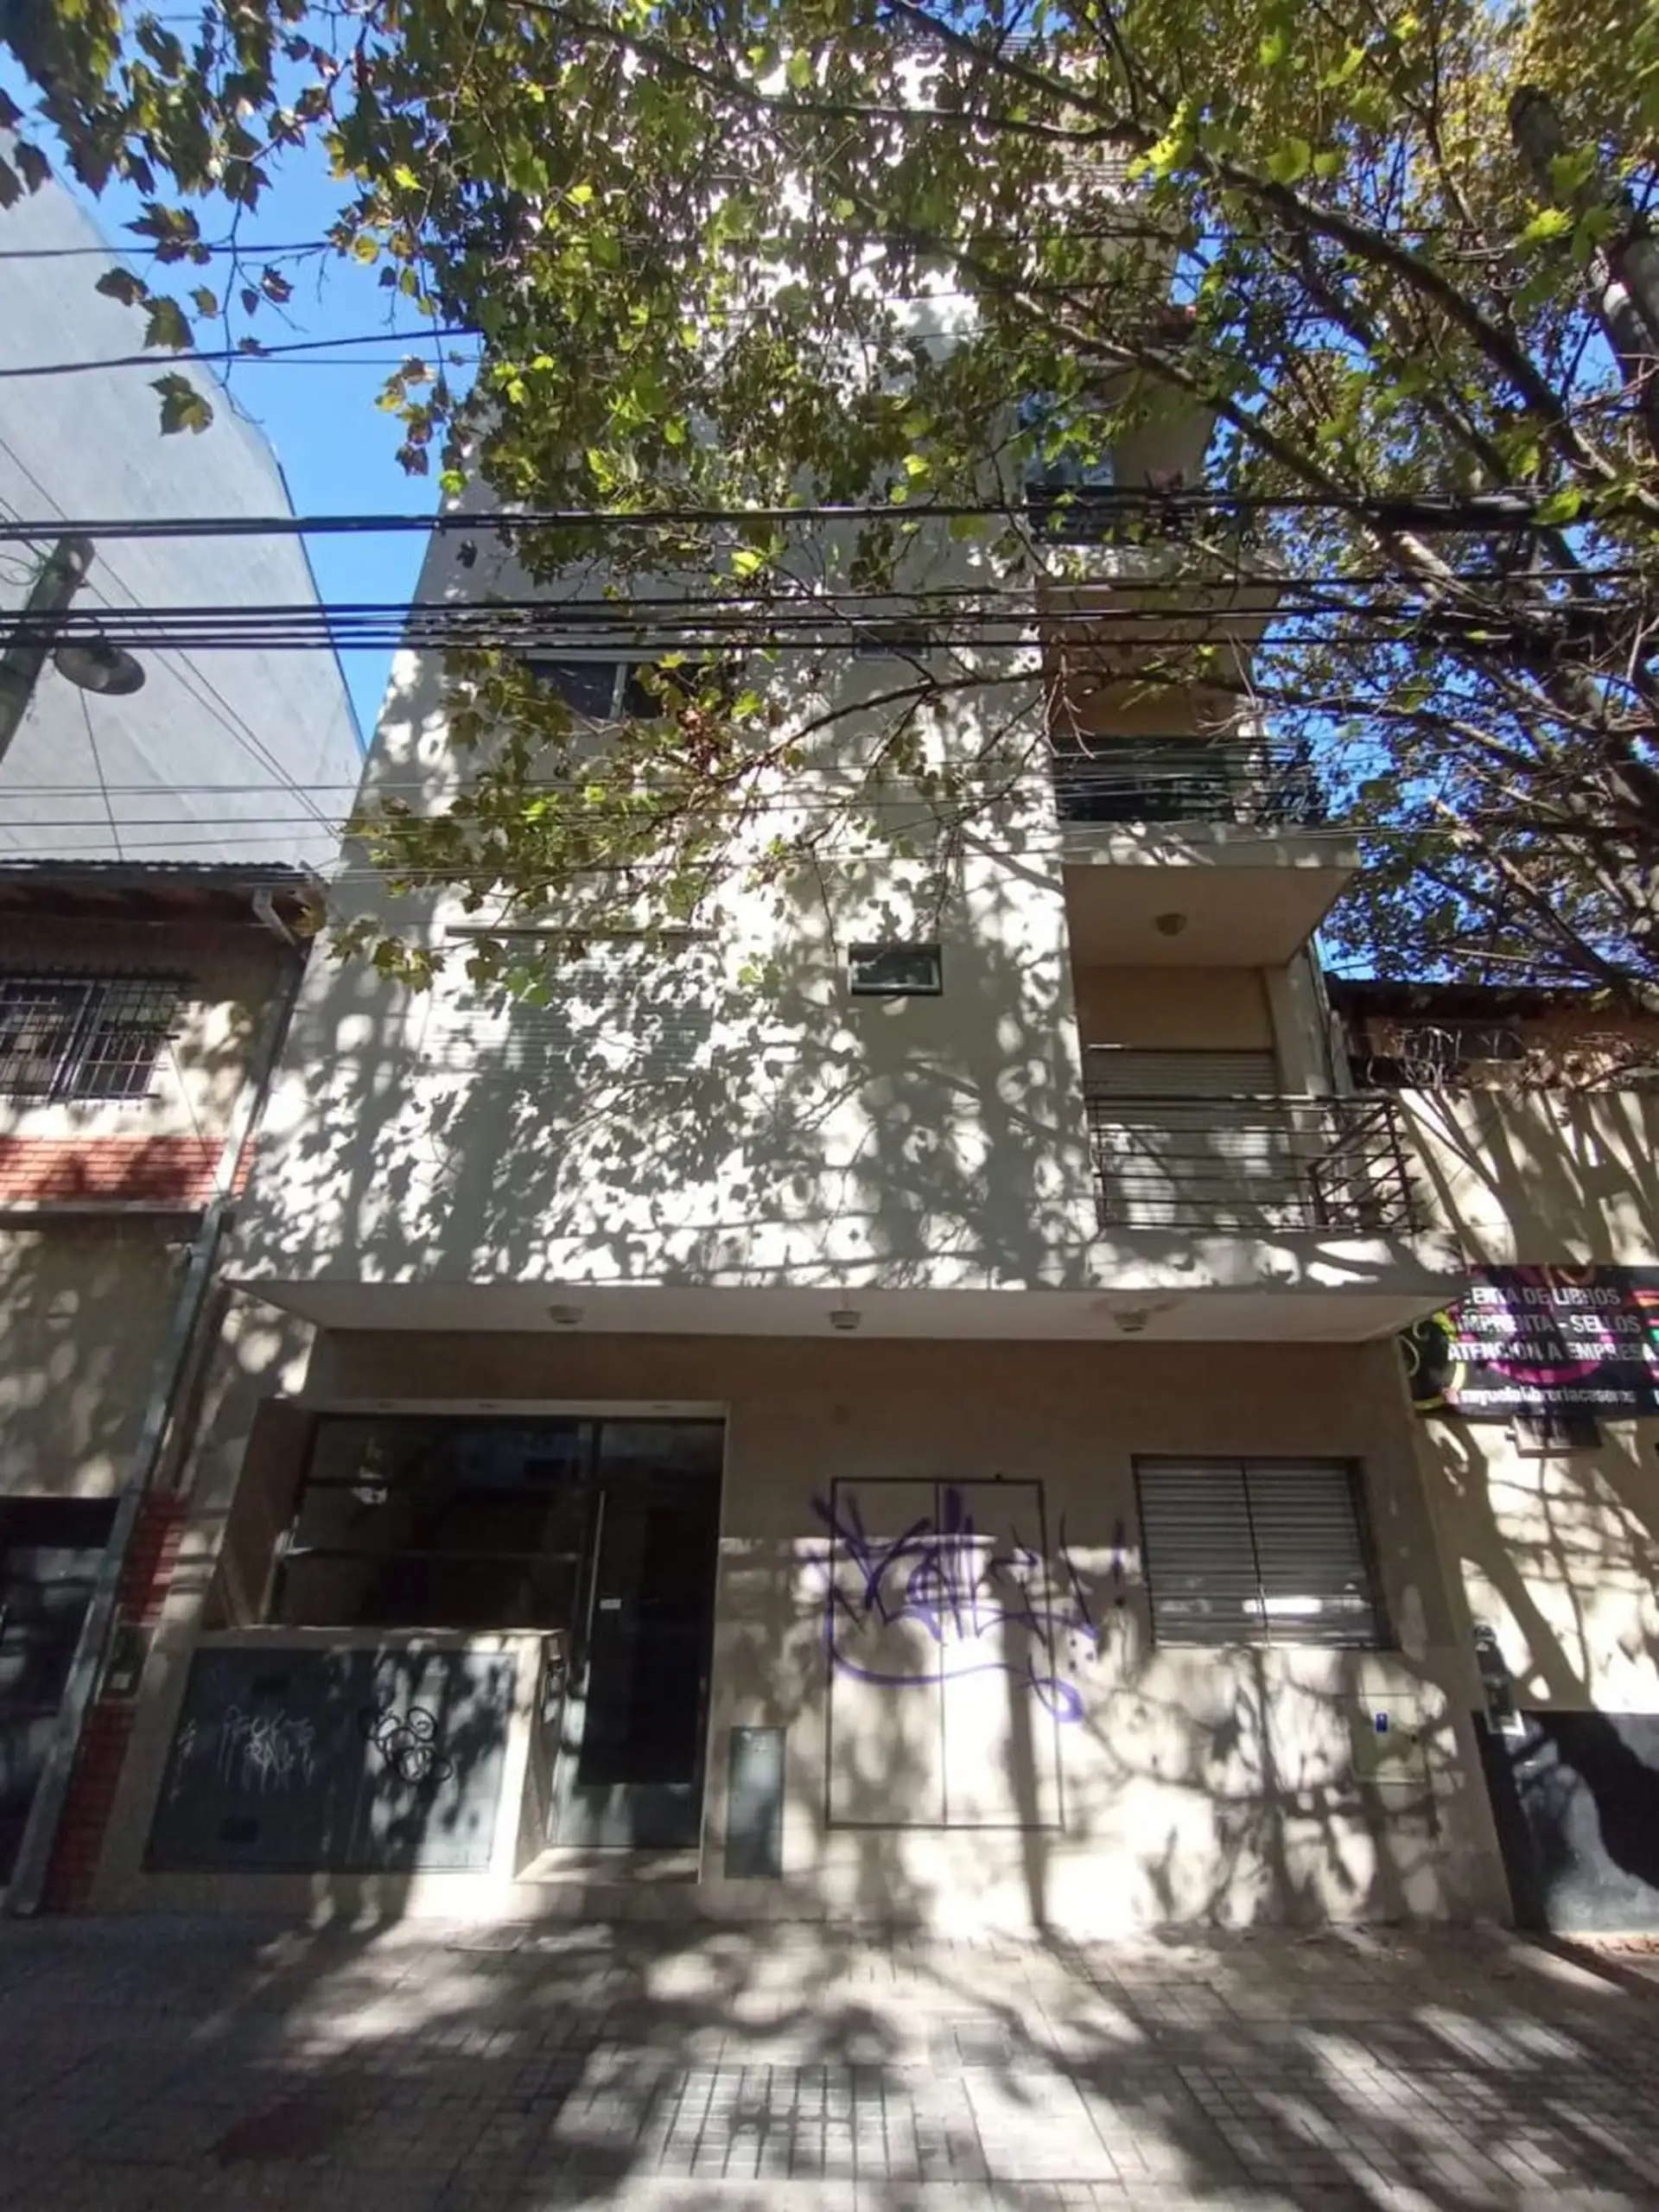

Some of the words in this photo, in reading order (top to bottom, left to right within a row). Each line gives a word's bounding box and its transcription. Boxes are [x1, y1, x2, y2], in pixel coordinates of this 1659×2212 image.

[1464, 1287, 1522, 1306] ENTA
[1522, 1287, 1551, 1305] DE
[1552, 1287, 1621, 1306] LIBROS
[1458, 1314, 1555, 1332] IMPRENTA
[1570, 1315, 1642, 1332] SELLOS
[1548, 1343, 1563, 1360] A
[1568, 1343, 1659, 1361] EMPRESA
